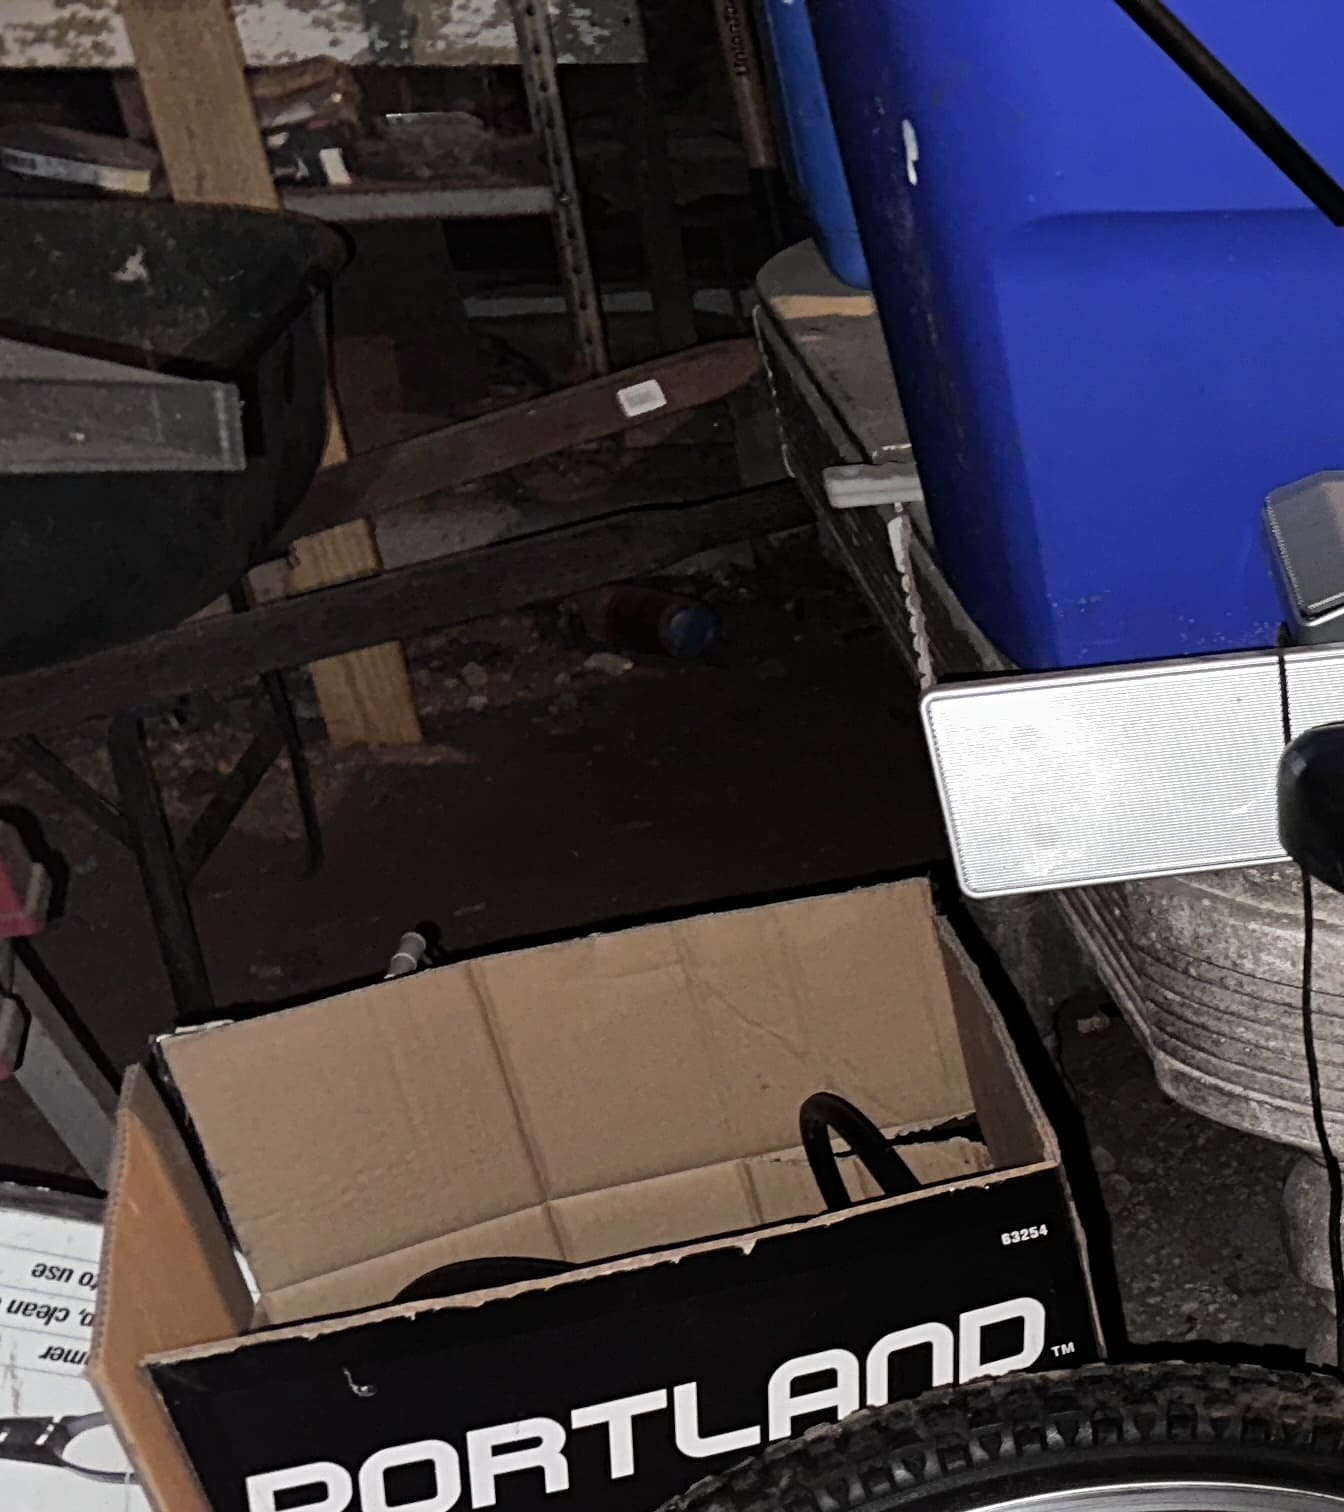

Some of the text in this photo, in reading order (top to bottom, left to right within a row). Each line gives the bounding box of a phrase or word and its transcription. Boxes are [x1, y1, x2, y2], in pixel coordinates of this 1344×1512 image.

[1000, 1224, 1049, 1246] 63254
[31, 1262, 75, 1284] use
[6, 1299, 70, 1327] clean
